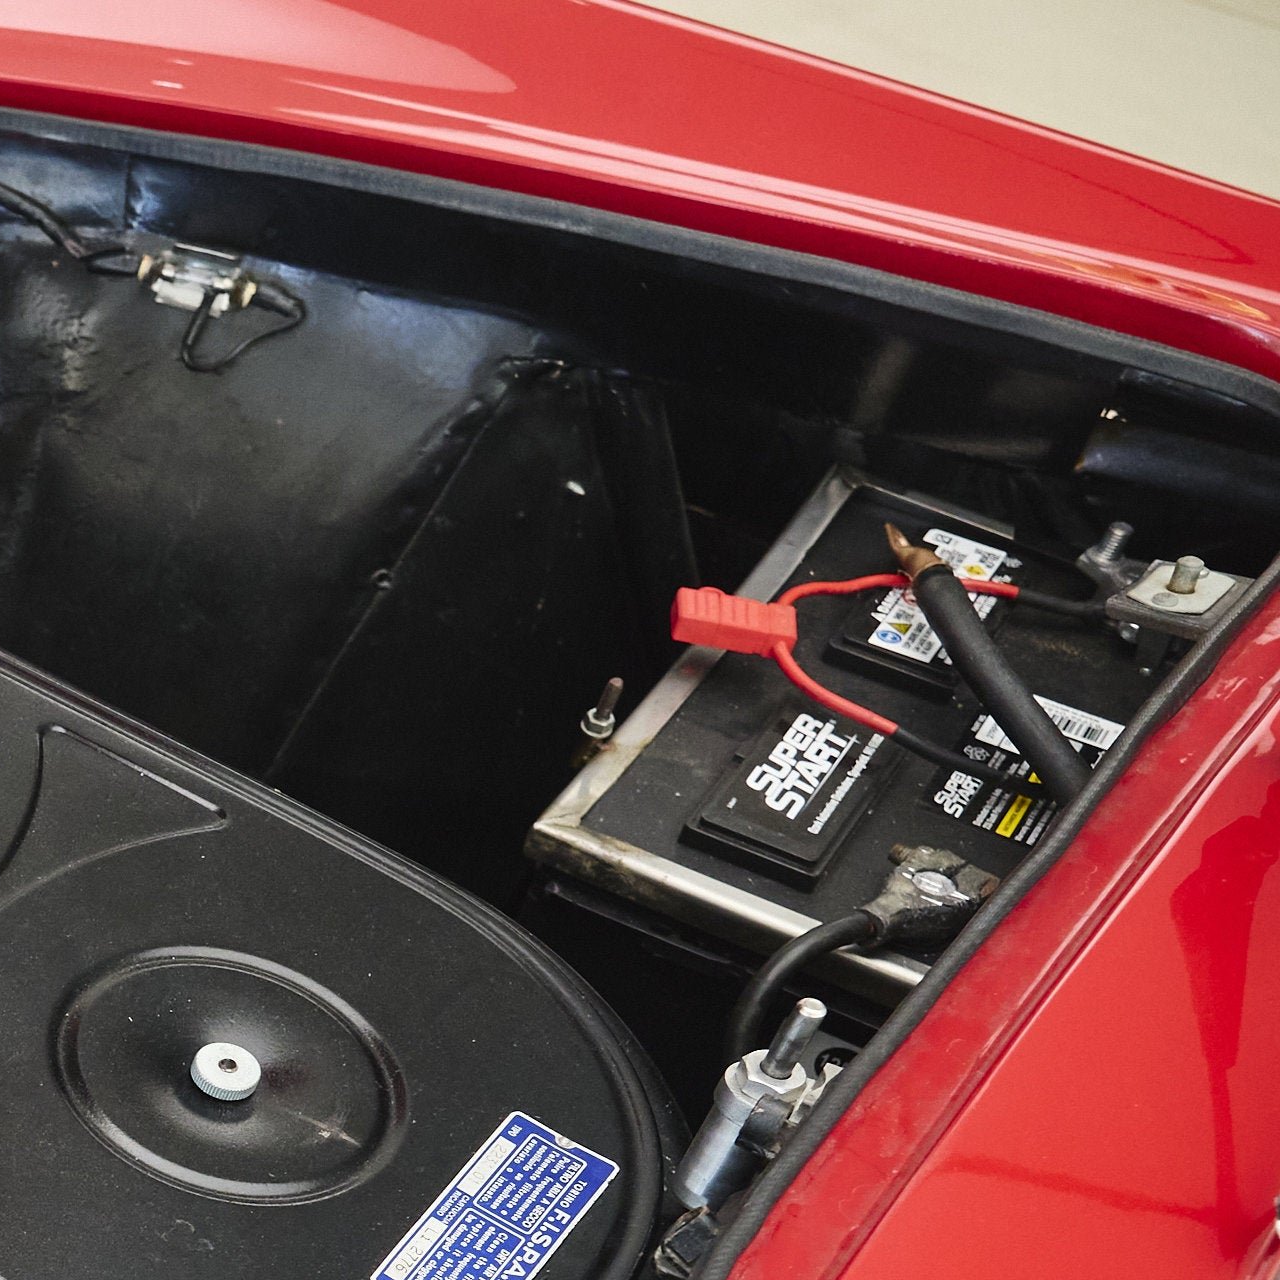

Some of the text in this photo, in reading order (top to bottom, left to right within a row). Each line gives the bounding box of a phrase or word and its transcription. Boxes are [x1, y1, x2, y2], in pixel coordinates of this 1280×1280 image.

[747, 715, 821, 798] SUPER
[766, 724, 850, 817] START
[560, 1162, 580, 1182] FILTRO
[506, 1182, 532, 1207] filtrante
[511, 1156, 570, 1220] Pulire frequentemente
[546, 1182, 562, 1197] ARIA
[560, 1181, 586, 1207] TORINO
[437, 1190, 461, 1215] RICAMBIO
[442, 1195, 469, 1223] CARTUCCIA
[465, 1214, 476, 1222] be
[522, 1205, 544, 1227] SECCO
[442, 1224, 467, 1251] damaged
[460, 1220, 484, 1246] replace
[473, 1226, 495, 1249] element
[486, 1233, 507, 1252] Clean
[502, 1209, 569, 1278] F.I.S.P.A.
[393, 1244, 424, 1274] 2776
[435, 1251, 443, 1259] or
[473, 1257, 487, 1268] the
[494, 1249, 509, 1264] DRY
[483, 1264, 496, 1276] AIR
